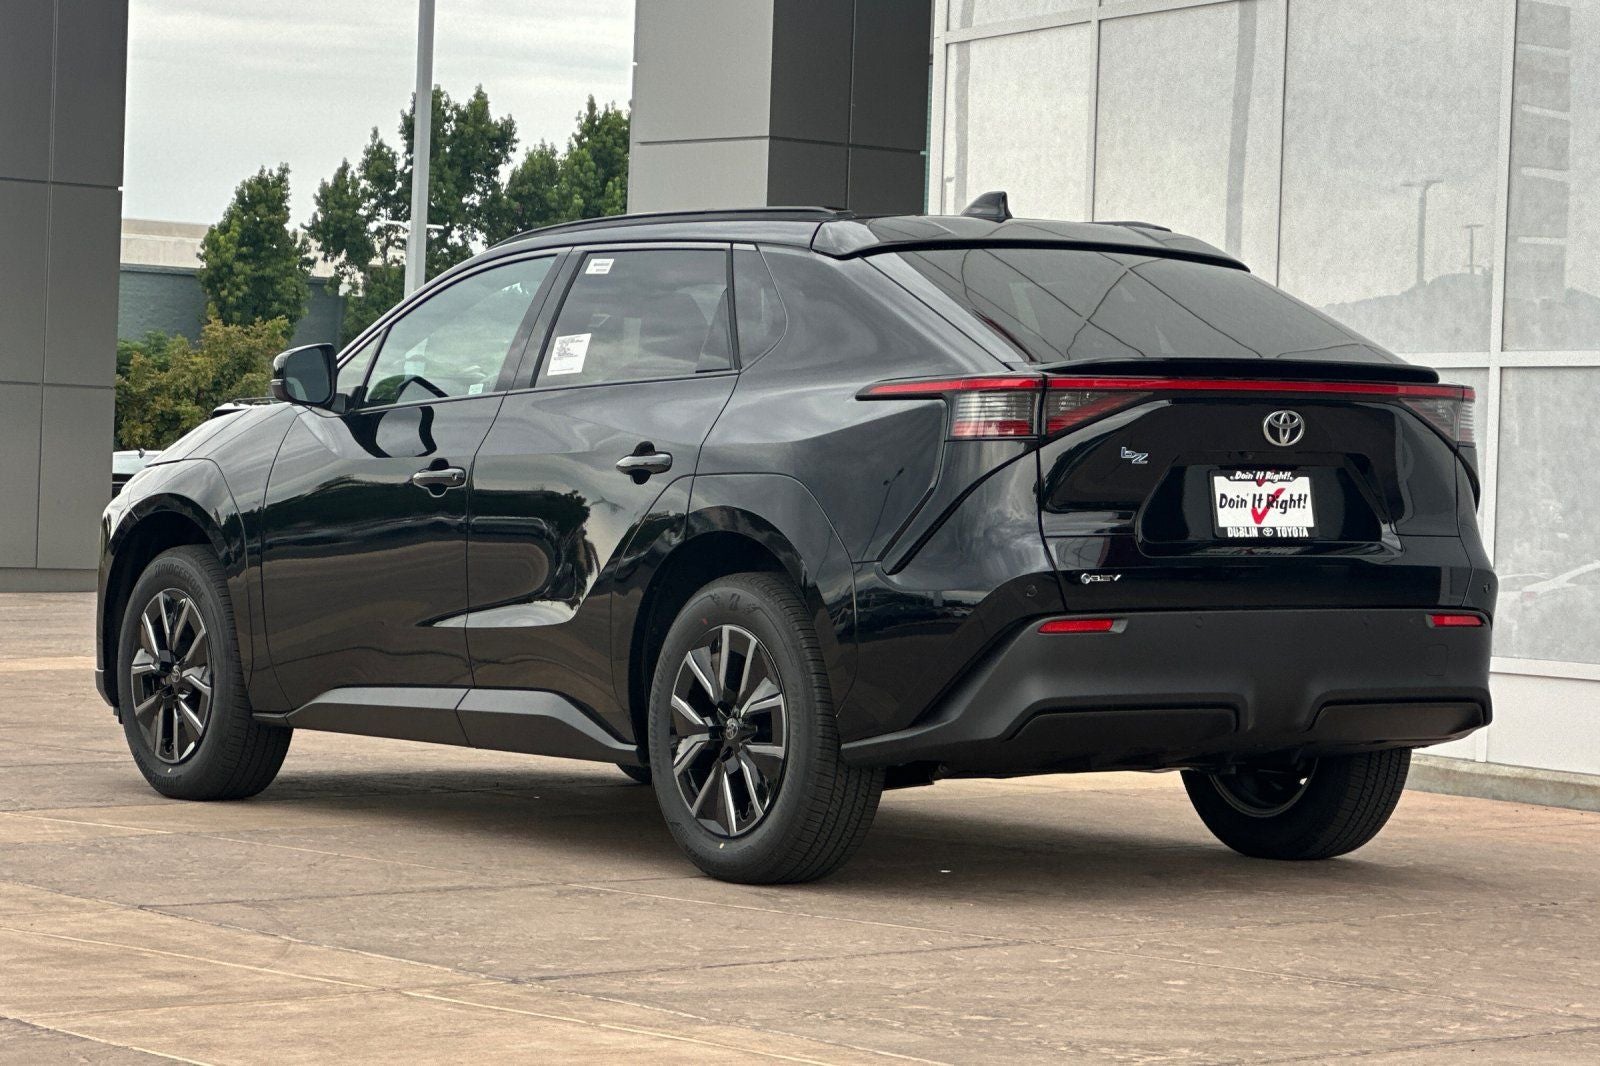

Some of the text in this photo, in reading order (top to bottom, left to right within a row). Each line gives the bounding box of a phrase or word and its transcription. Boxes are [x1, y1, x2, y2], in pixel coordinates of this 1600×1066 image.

[1255, 470, 1264, 480] It
[1265, 471, 1292, 483] Right!
[1219, 492, 1307, 514] Doin' It Right!
[1227, 526, 1308, 537] DUBLIN TOYOTA
